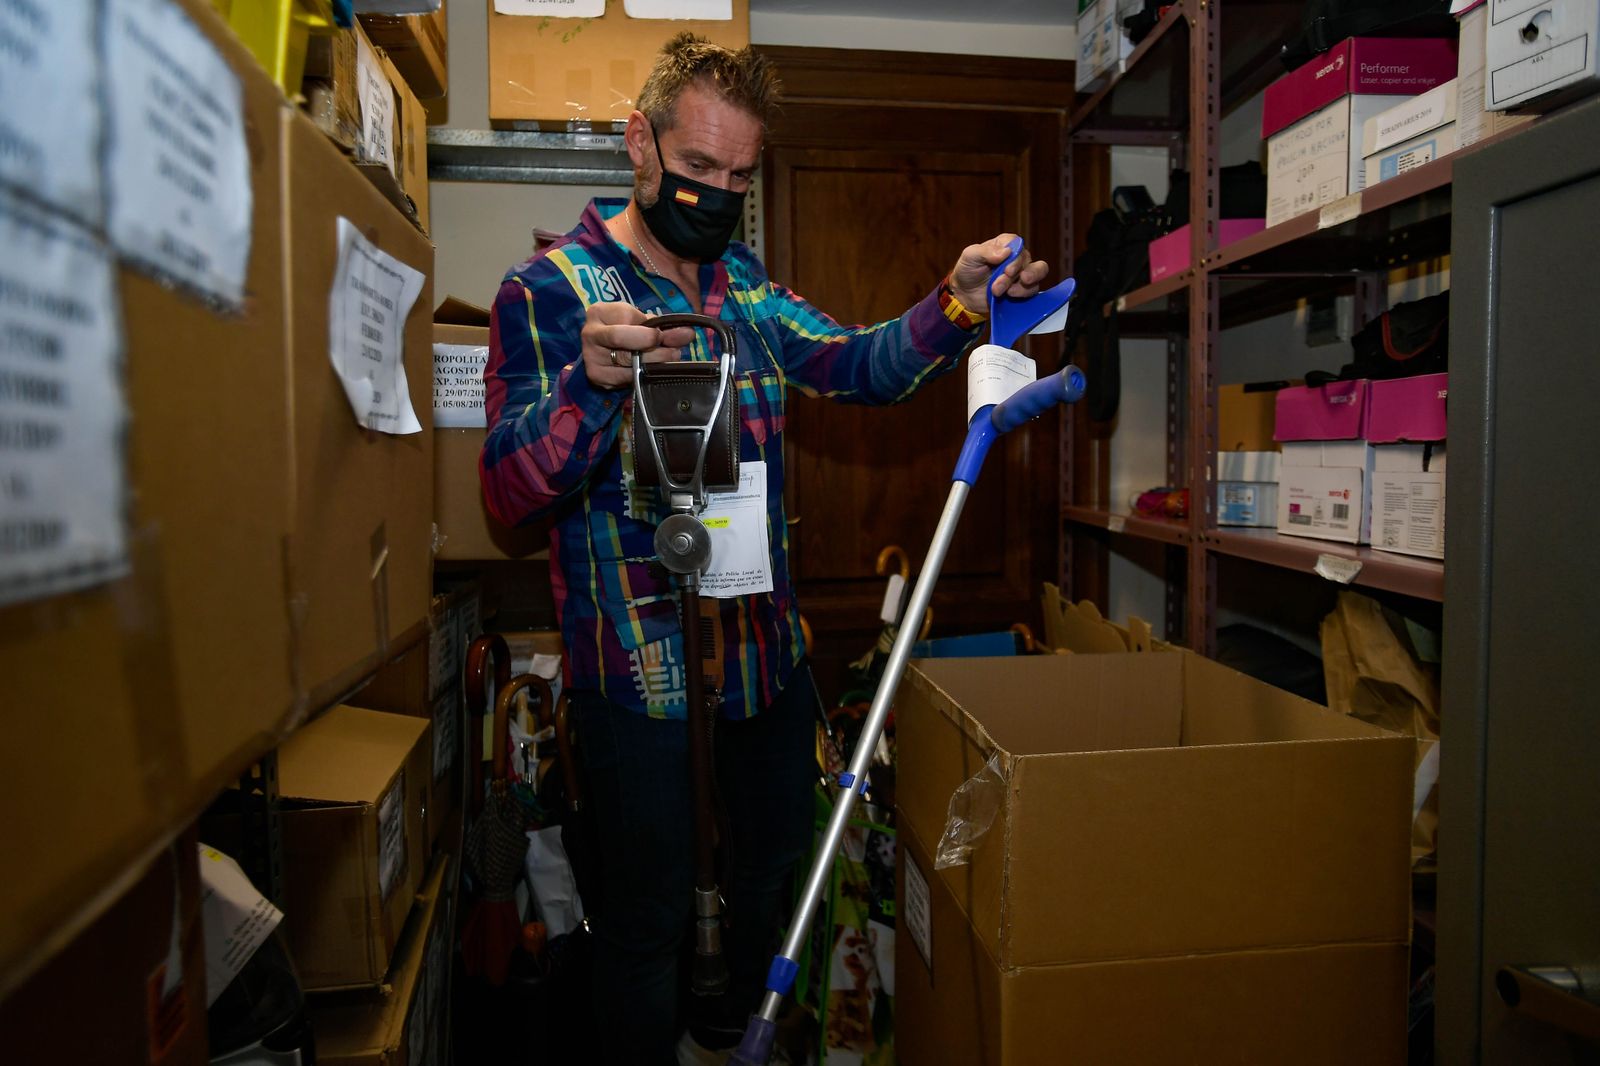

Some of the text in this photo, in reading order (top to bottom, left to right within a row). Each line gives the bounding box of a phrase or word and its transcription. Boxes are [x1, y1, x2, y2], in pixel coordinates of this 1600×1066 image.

[1315, 63, 1335, 80] xerox
[1360, 63, 1410, 74] Performer
[1381, 77, 1401, 86] copier
[1417, 77, 1436, 86] inkjet
[436, 366, 478, 375] AGOSTO
[445, 389, 485, 398] 29/07/201
